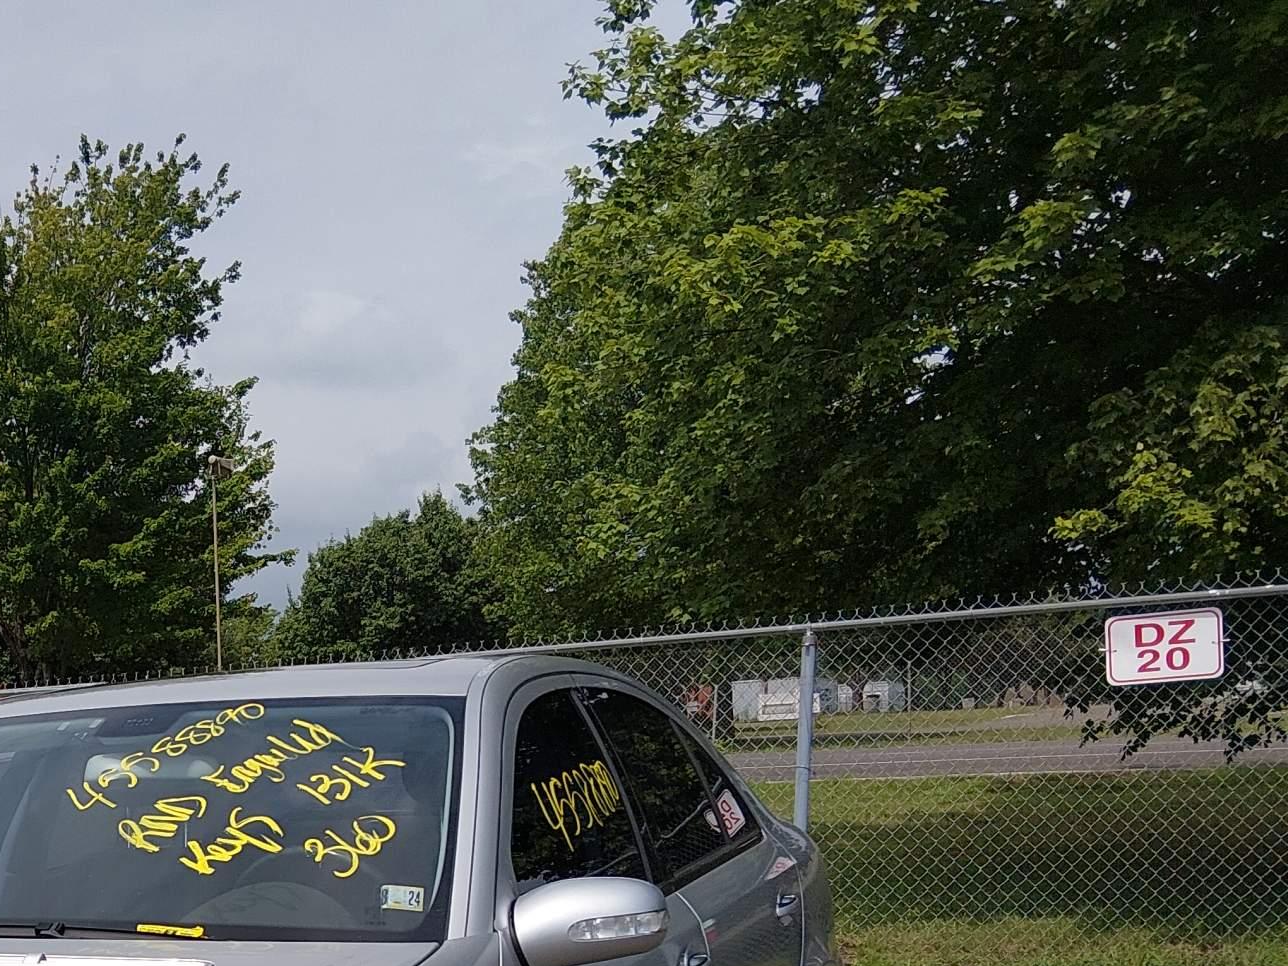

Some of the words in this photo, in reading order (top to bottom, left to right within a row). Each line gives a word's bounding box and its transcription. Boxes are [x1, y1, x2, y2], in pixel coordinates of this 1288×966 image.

[1134, 619, 1196, 647] DZ
[1136, 646, 1191, 673] 20
[408, 890, 421, 907] 24
